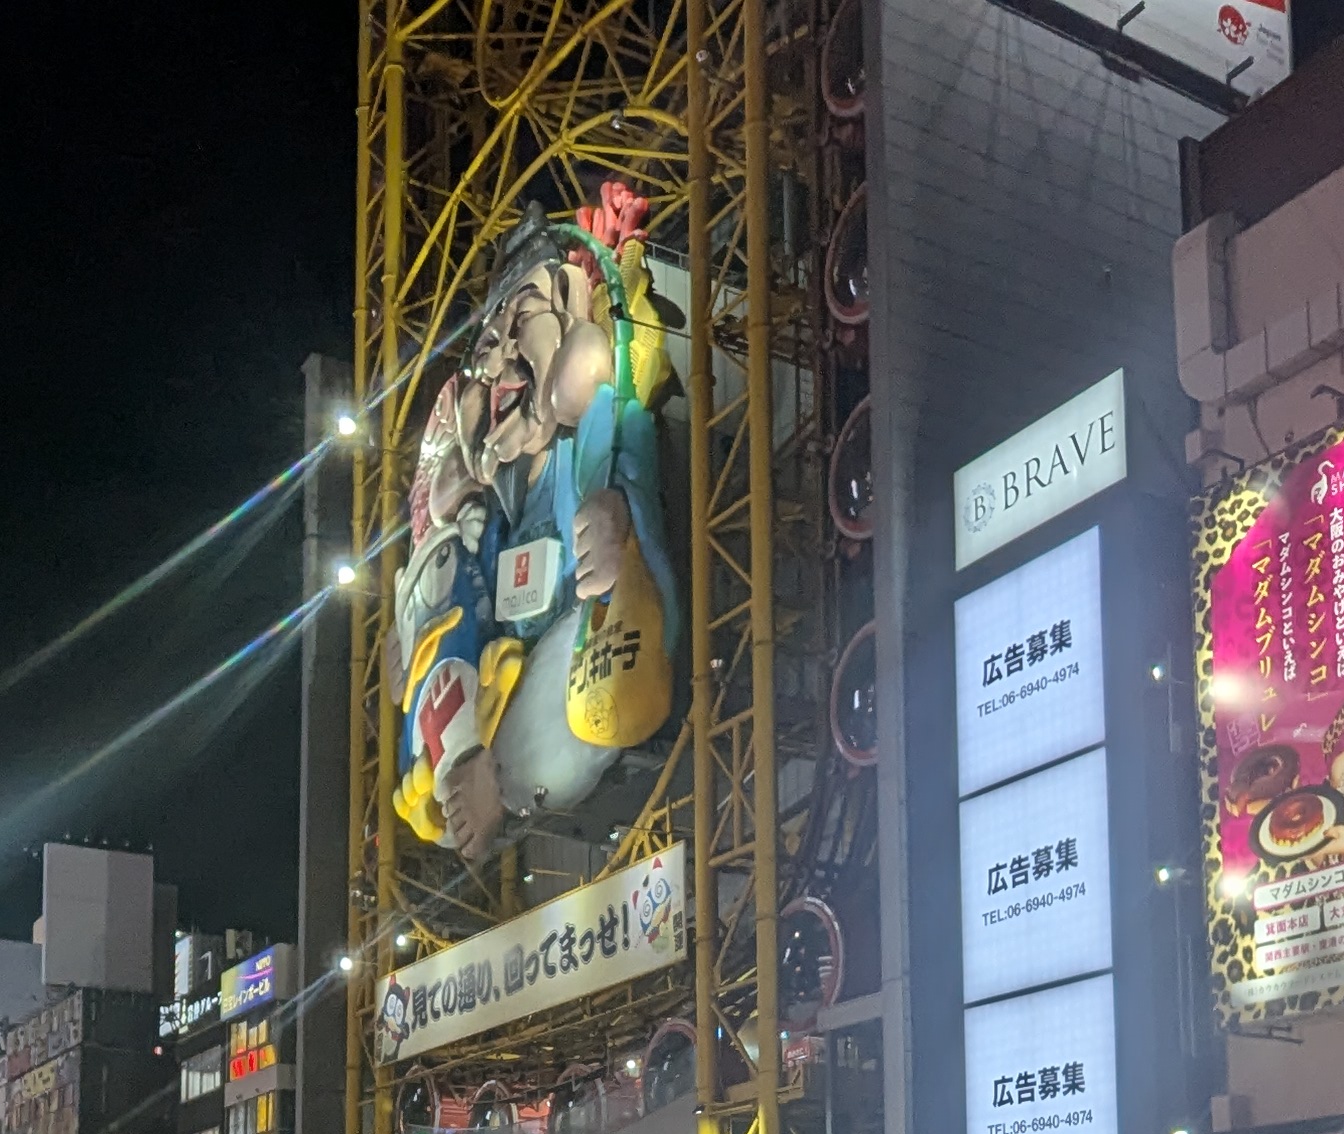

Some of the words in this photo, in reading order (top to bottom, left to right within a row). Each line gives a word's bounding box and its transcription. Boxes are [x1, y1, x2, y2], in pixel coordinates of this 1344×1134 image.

[1002, 411, 1117, 511] BRAVE
[1278, 532, 1297, 682] マダムシンコといえば
[1303, 514, 1329, 702] 「マダムシンコ」
[982, 619, 1074, 688] 広告募集
[977, 661, 1080, 718] TEL:06-6940-4974
[988, 837, 1079, 897] 広告募集
[982, 881, 1086, 927] TEL:06-6940-4974
[992, 1061, 1085, 1109] 広告募集
